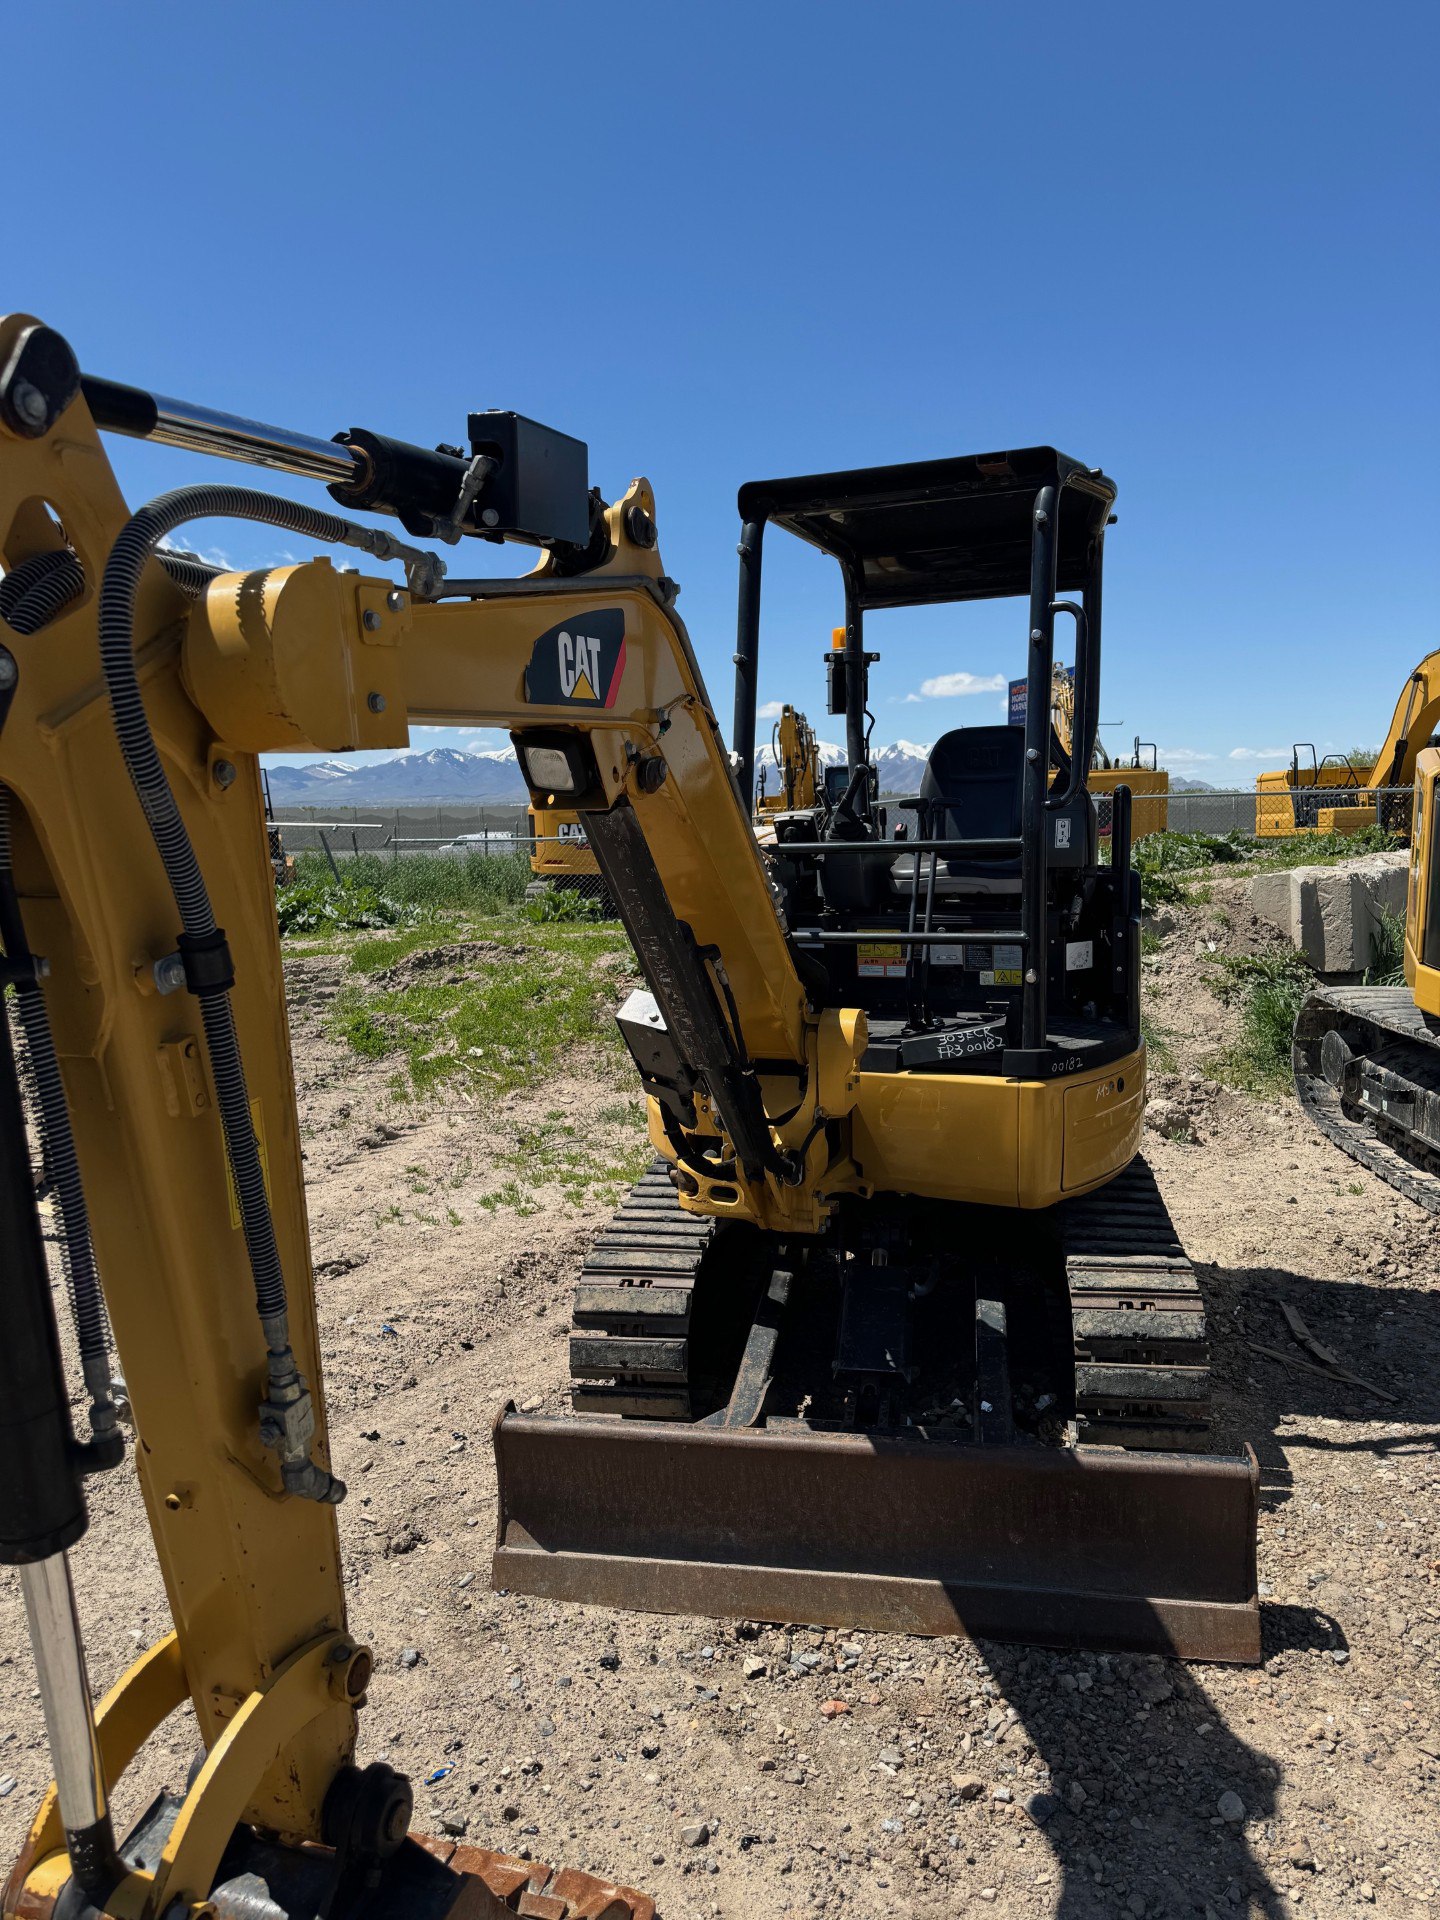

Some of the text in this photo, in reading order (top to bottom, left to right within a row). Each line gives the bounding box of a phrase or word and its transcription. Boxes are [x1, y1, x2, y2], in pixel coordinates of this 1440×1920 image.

[557, 631, 601, 700] CAT
[966, 1036, 1007, 1053] 00182
[1051, 1056, 1084, 1073] 00182
